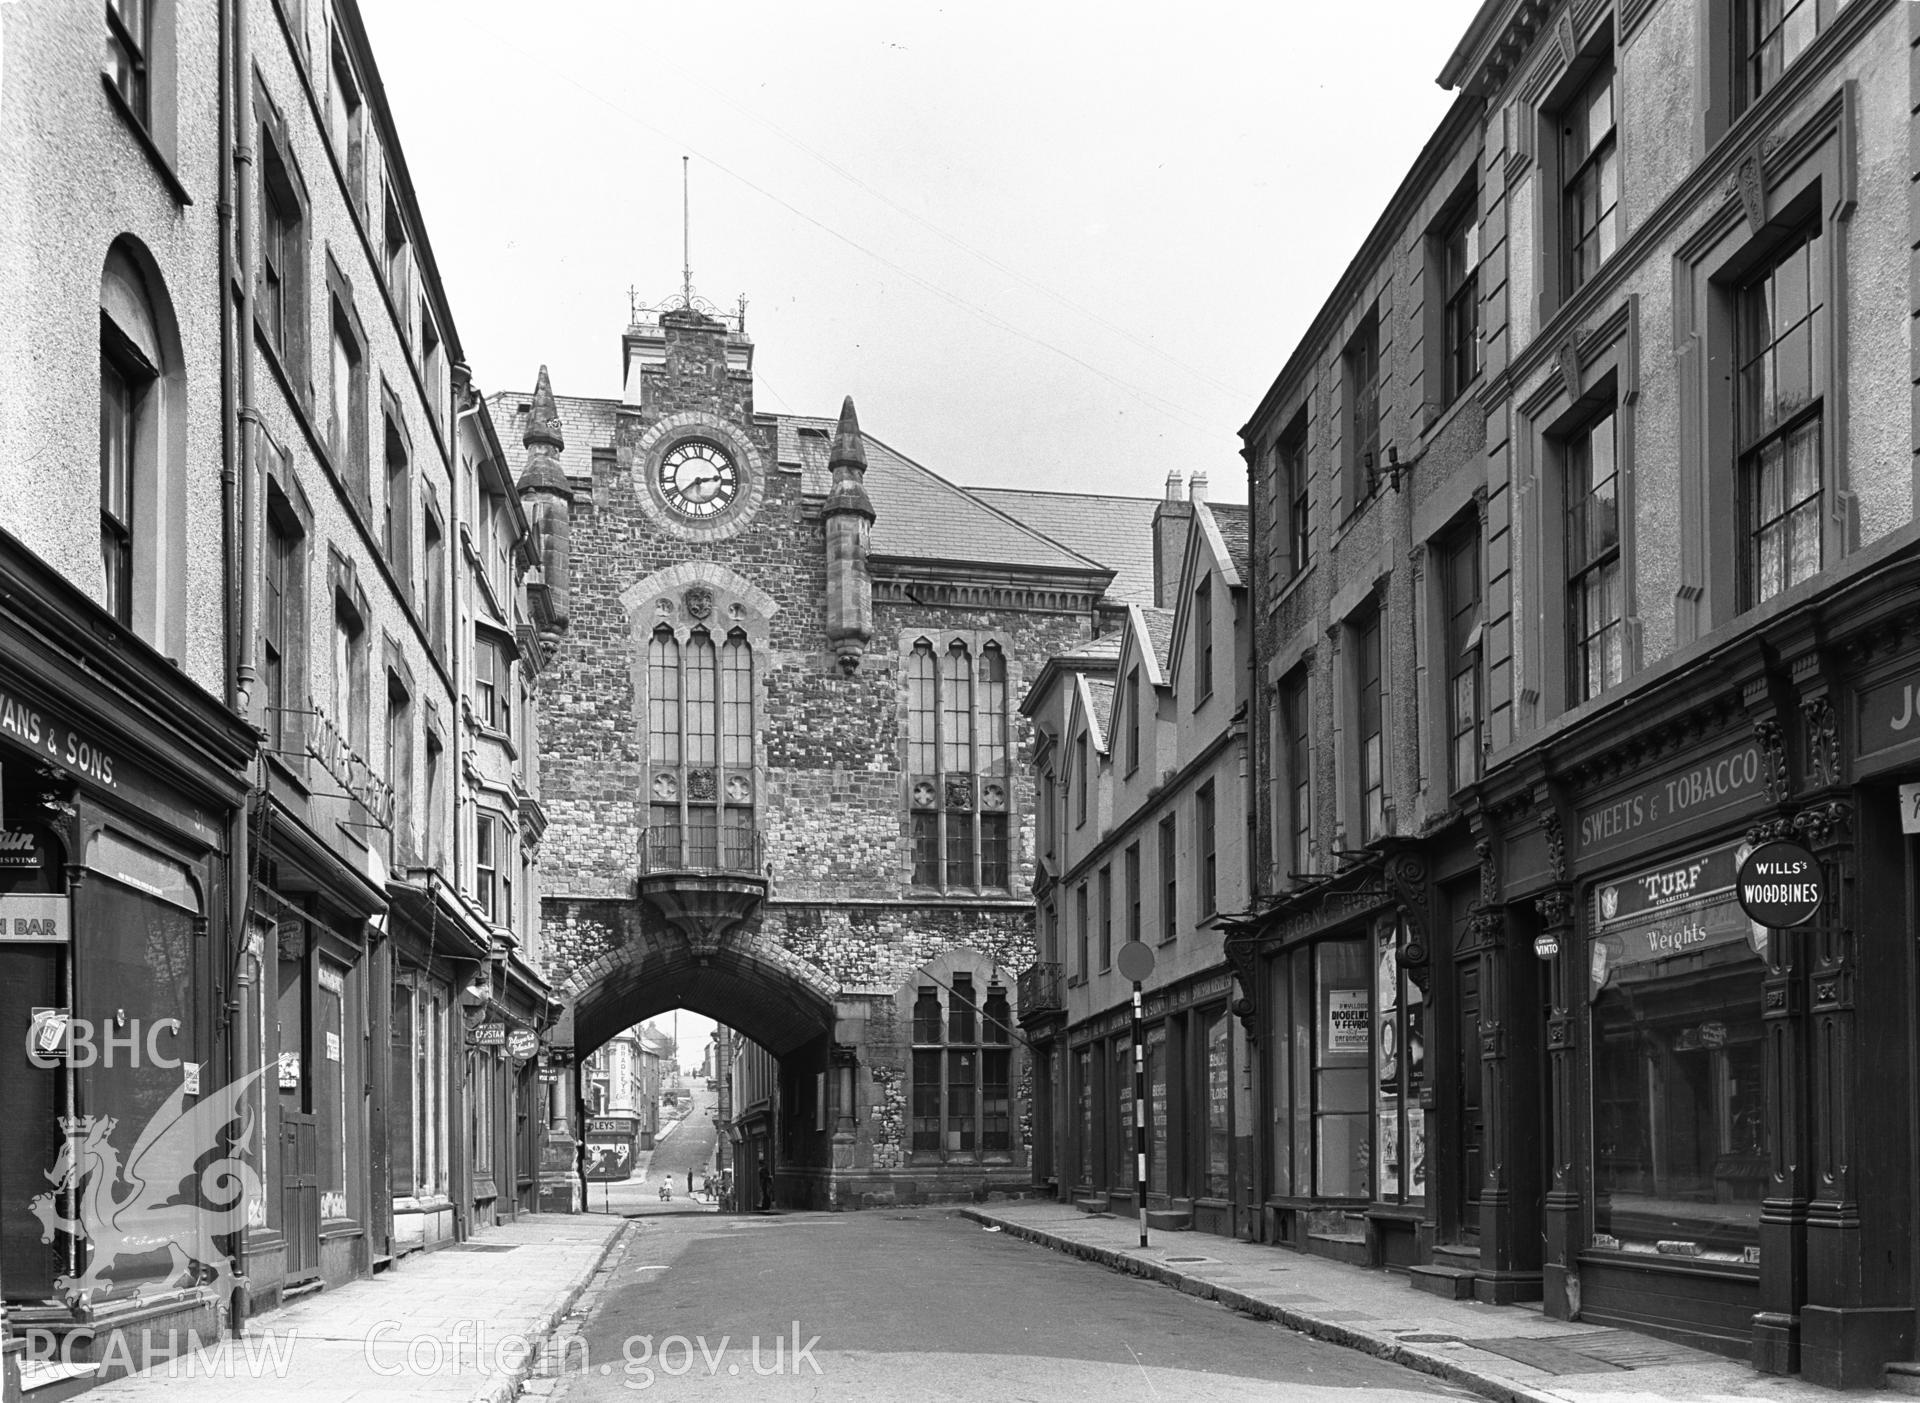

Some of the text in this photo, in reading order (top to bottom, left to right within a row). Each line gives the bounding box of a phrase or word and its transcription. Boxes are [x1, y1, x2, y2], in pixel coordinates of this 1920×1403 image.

[1890, 684, 1920, 730] J
[47, 728, 57, 755] &
[1582, 795, 1643, 846] SWEETS
[1664, 749, 1758, 814] TOBACCO
[1744, 883, 1818, 904] WOODBINES
[14, 918, 57, 936] BAR
[1646, 923, 1707, 951] Weights
